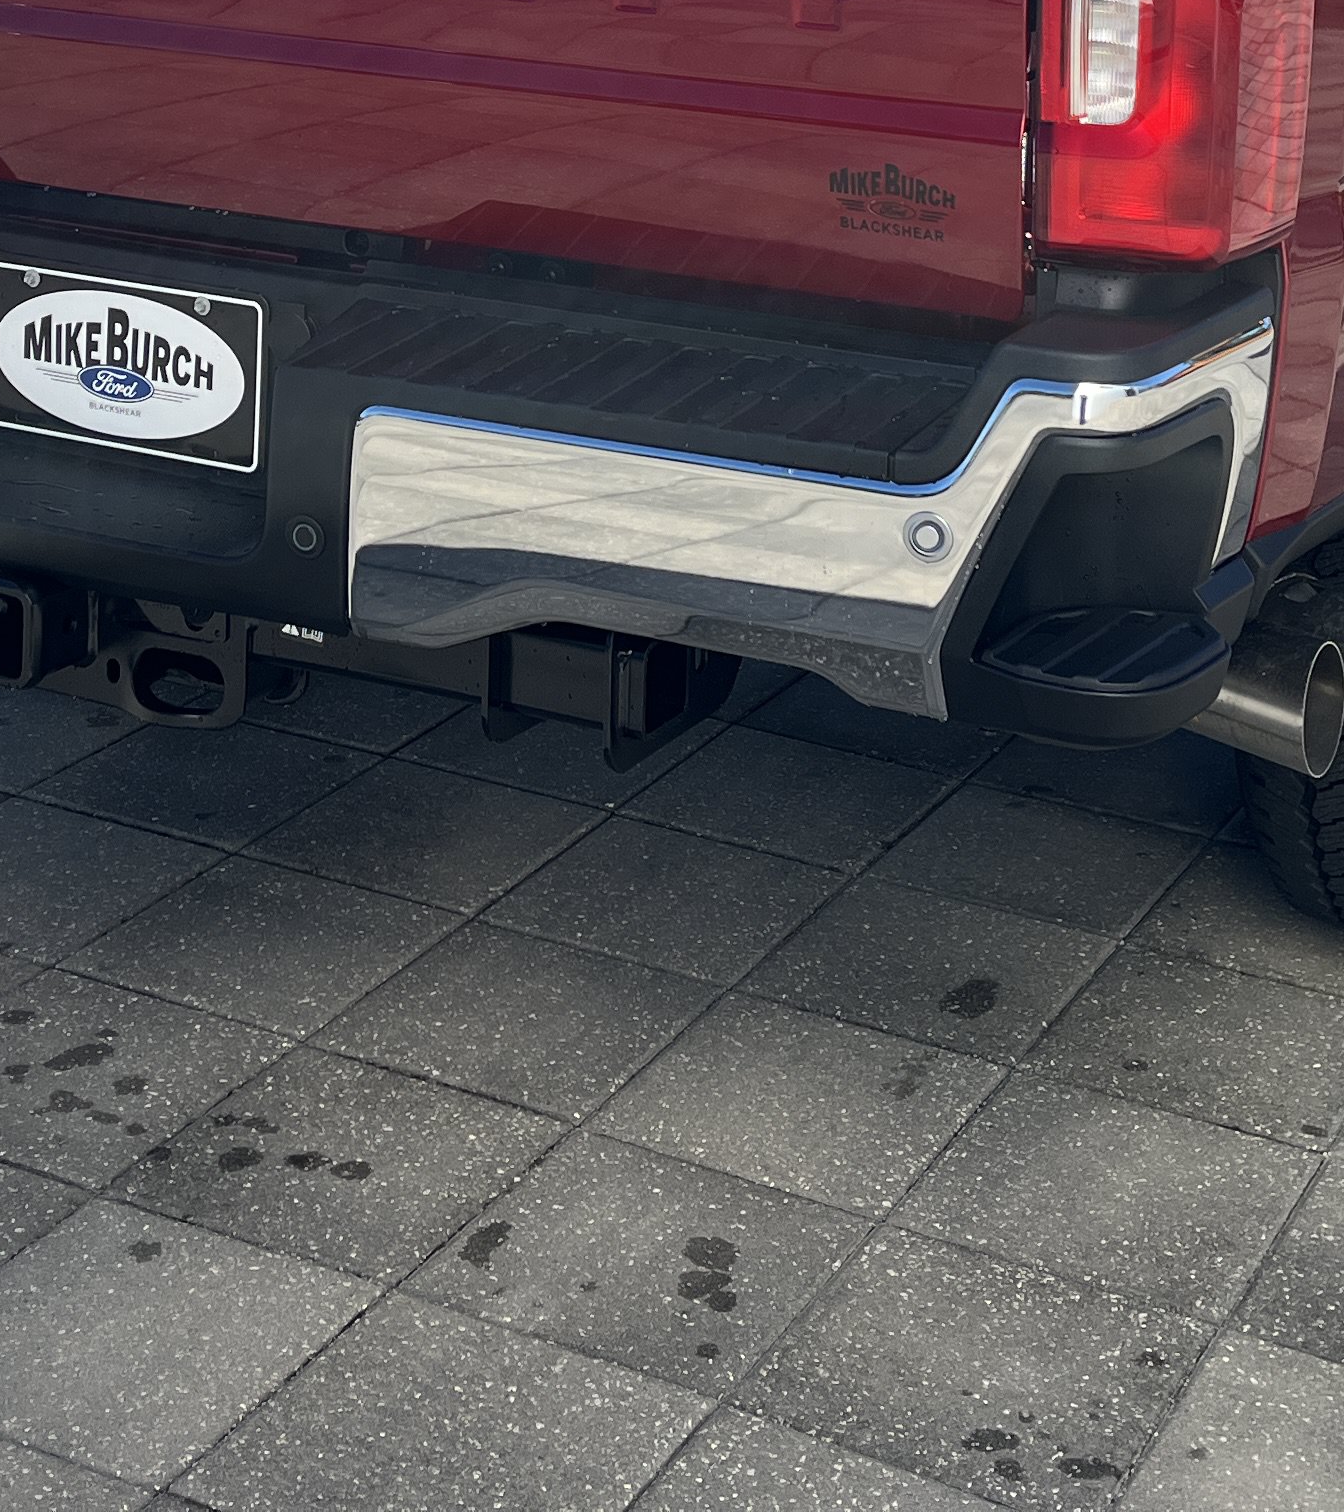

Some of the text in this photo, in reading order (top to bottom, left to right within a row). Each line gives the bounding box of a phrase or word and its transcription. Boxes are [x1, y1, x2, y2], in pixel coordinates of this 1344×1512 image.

[839, 216, 945, 242] BLACKSHEAR
[92, 370, 139, 398] Ford
[89, 401, 142, 418] BLACKSHEAR
